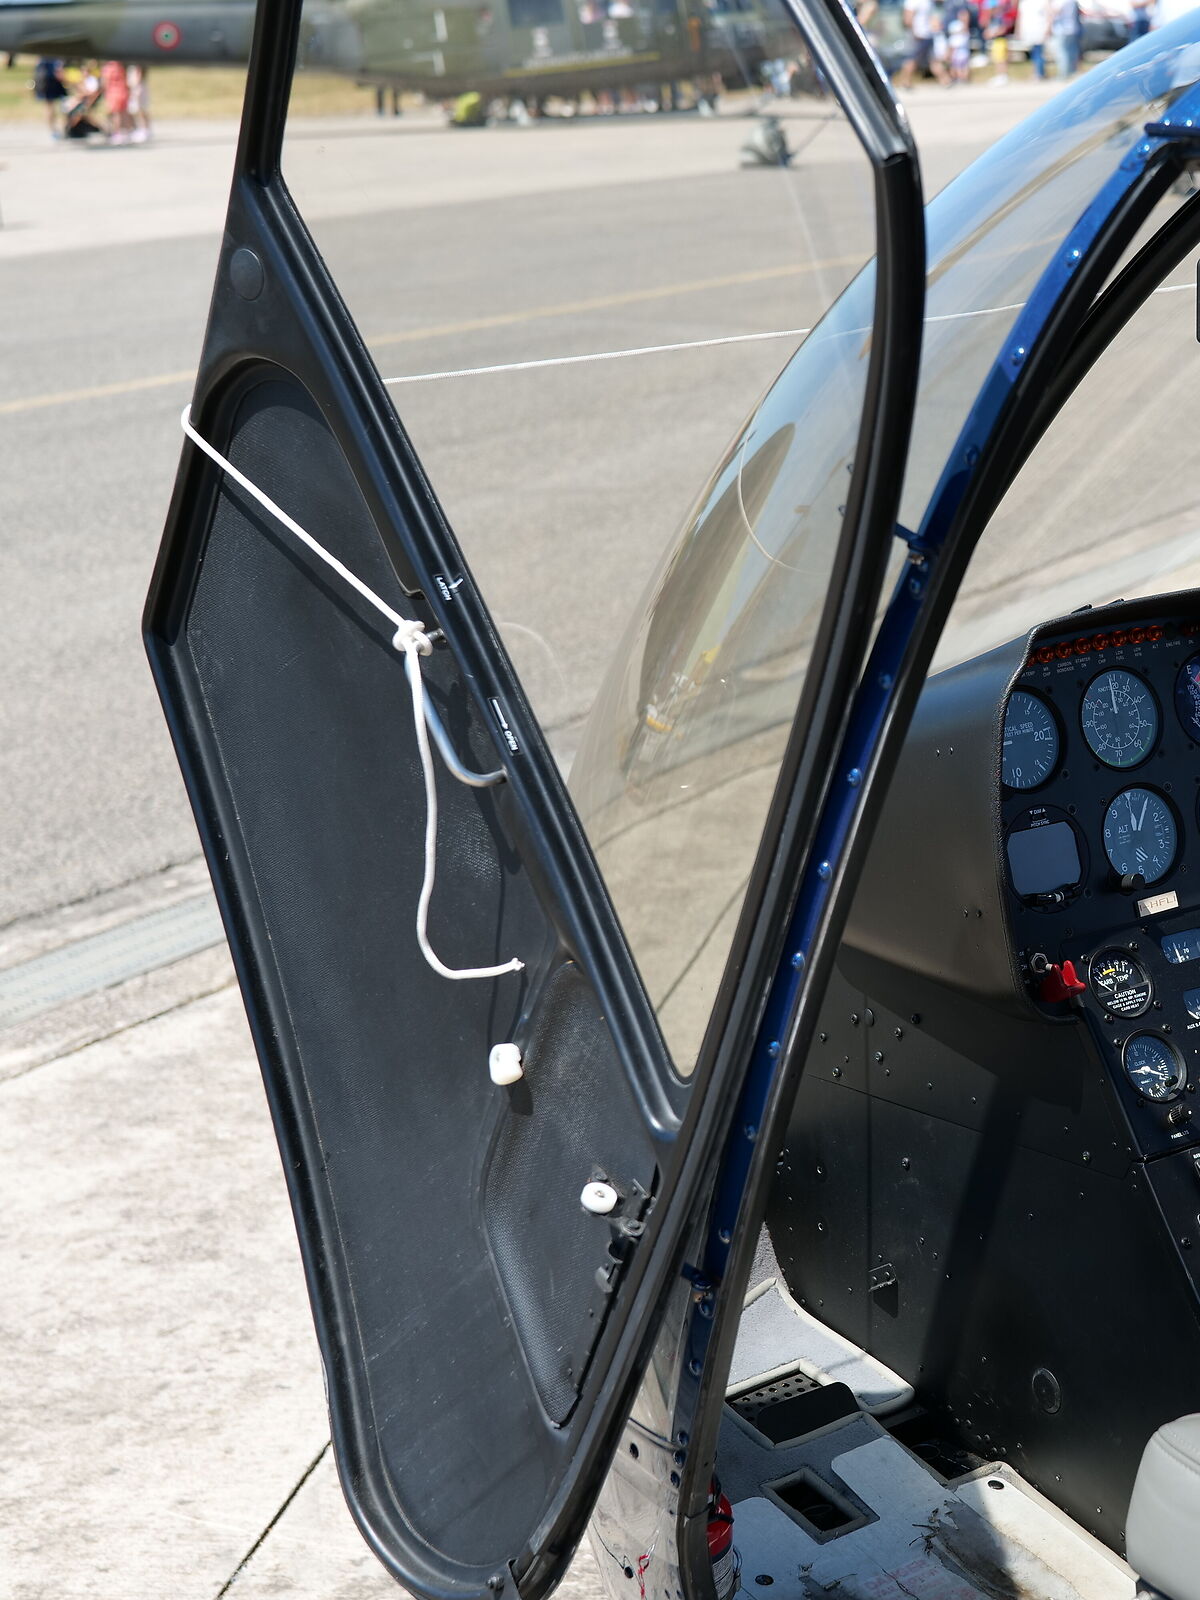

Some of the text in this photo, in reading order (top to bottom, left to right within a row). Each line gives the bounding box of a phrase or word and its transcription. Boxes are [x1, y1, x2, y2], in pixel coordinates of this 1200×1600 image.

[435, 576, 453, 601] LATCH
[1186, 665, 1193, 675] E
[504, 731, 519, 751] OPEN
[1033, 730, 1045, 742] 20
[1012, 767, 1022, 778] 10
[1111, 809, 1118, 819] 9
[1153, 812, 1160, 822] 2
[1104, 828, 1112, 838] 8
[1118, 824, 1129, 834] ALT
[1158, 839, 1165, 849] 3
[1152, 855, 1159, 864] 4
[1121, 863, 1129, 872] 6
[1138, 865, 1145, 875] 5
[1114, 988, 1137, 999] CAUTION
[1171, 1132, 1183, 1140] PANEL
